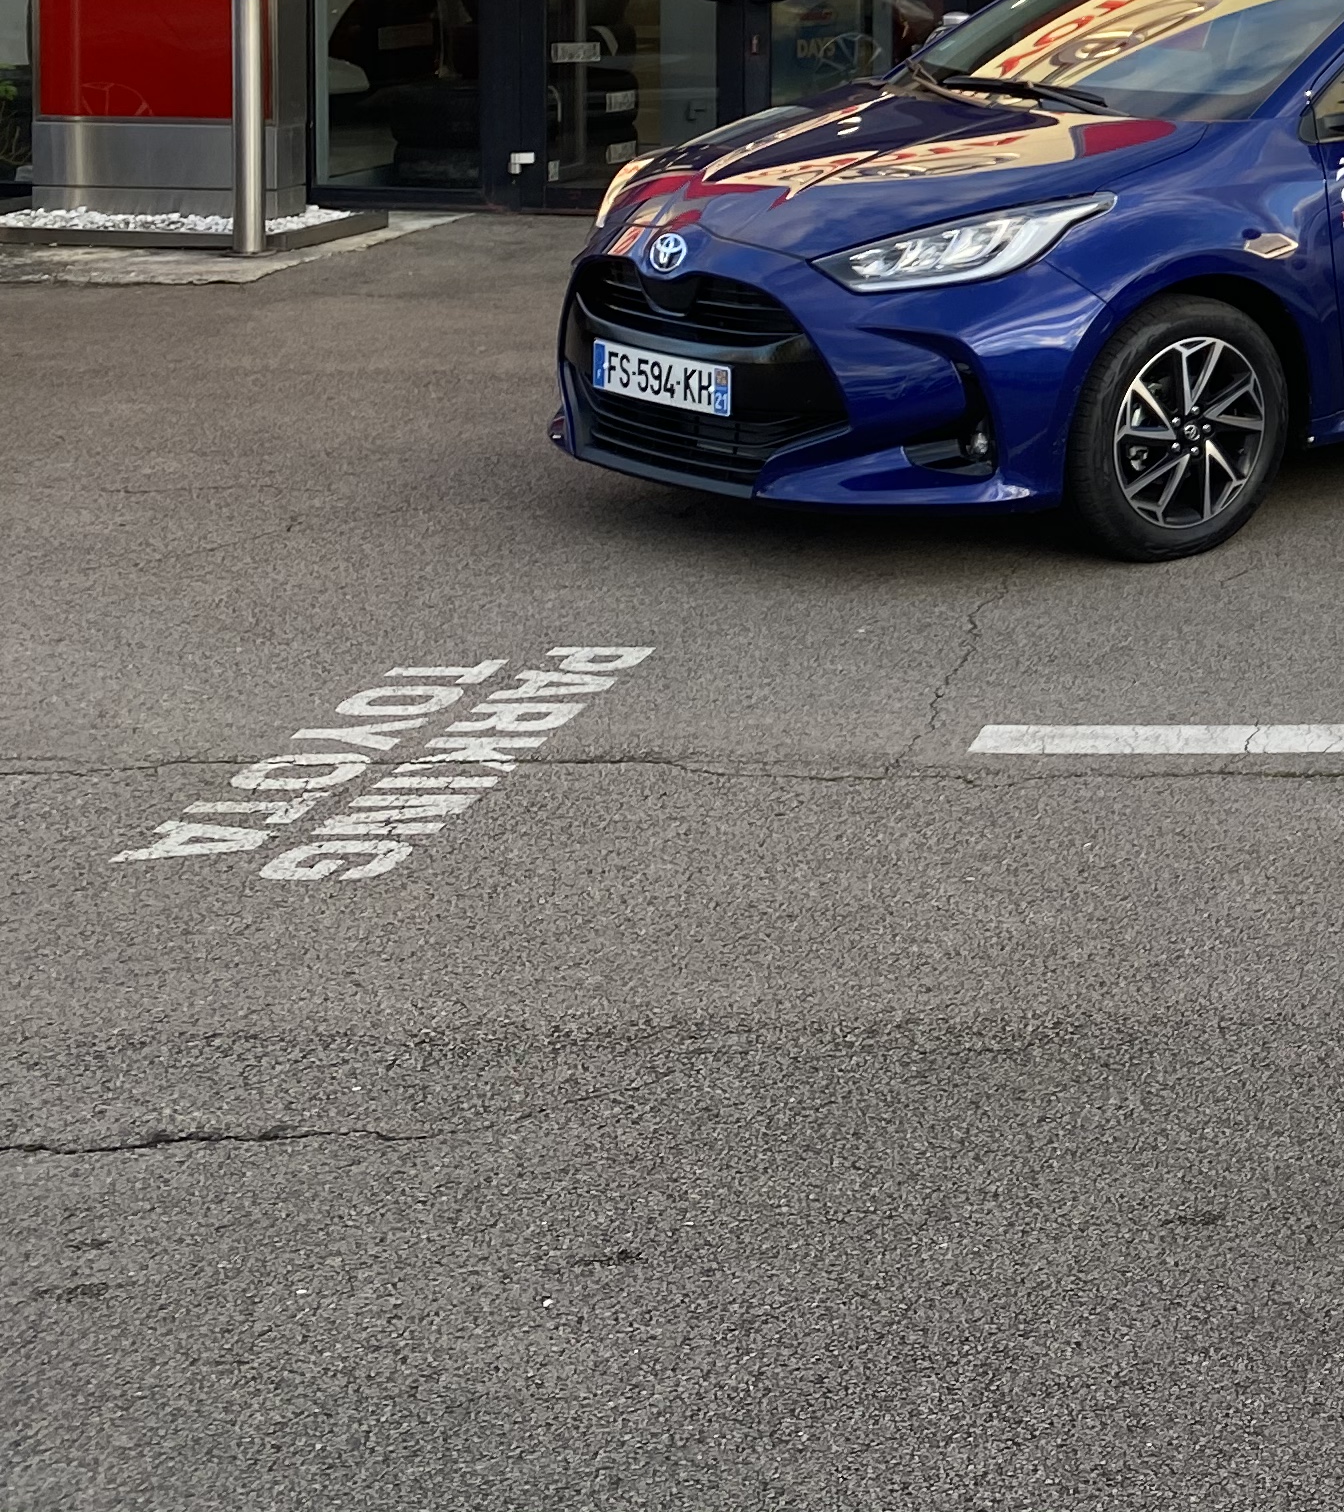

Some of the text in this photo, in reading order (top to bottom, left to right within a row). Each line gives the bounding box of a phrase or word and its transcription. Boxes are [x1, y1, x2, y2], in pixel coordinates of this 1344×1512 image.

[607, 351, 712, 406] FS-594-KH
[715, 392, 728, 410] 21
[108, 658, 510, 864] TOYOTA
[258, 645, 657, 881] PARKING
